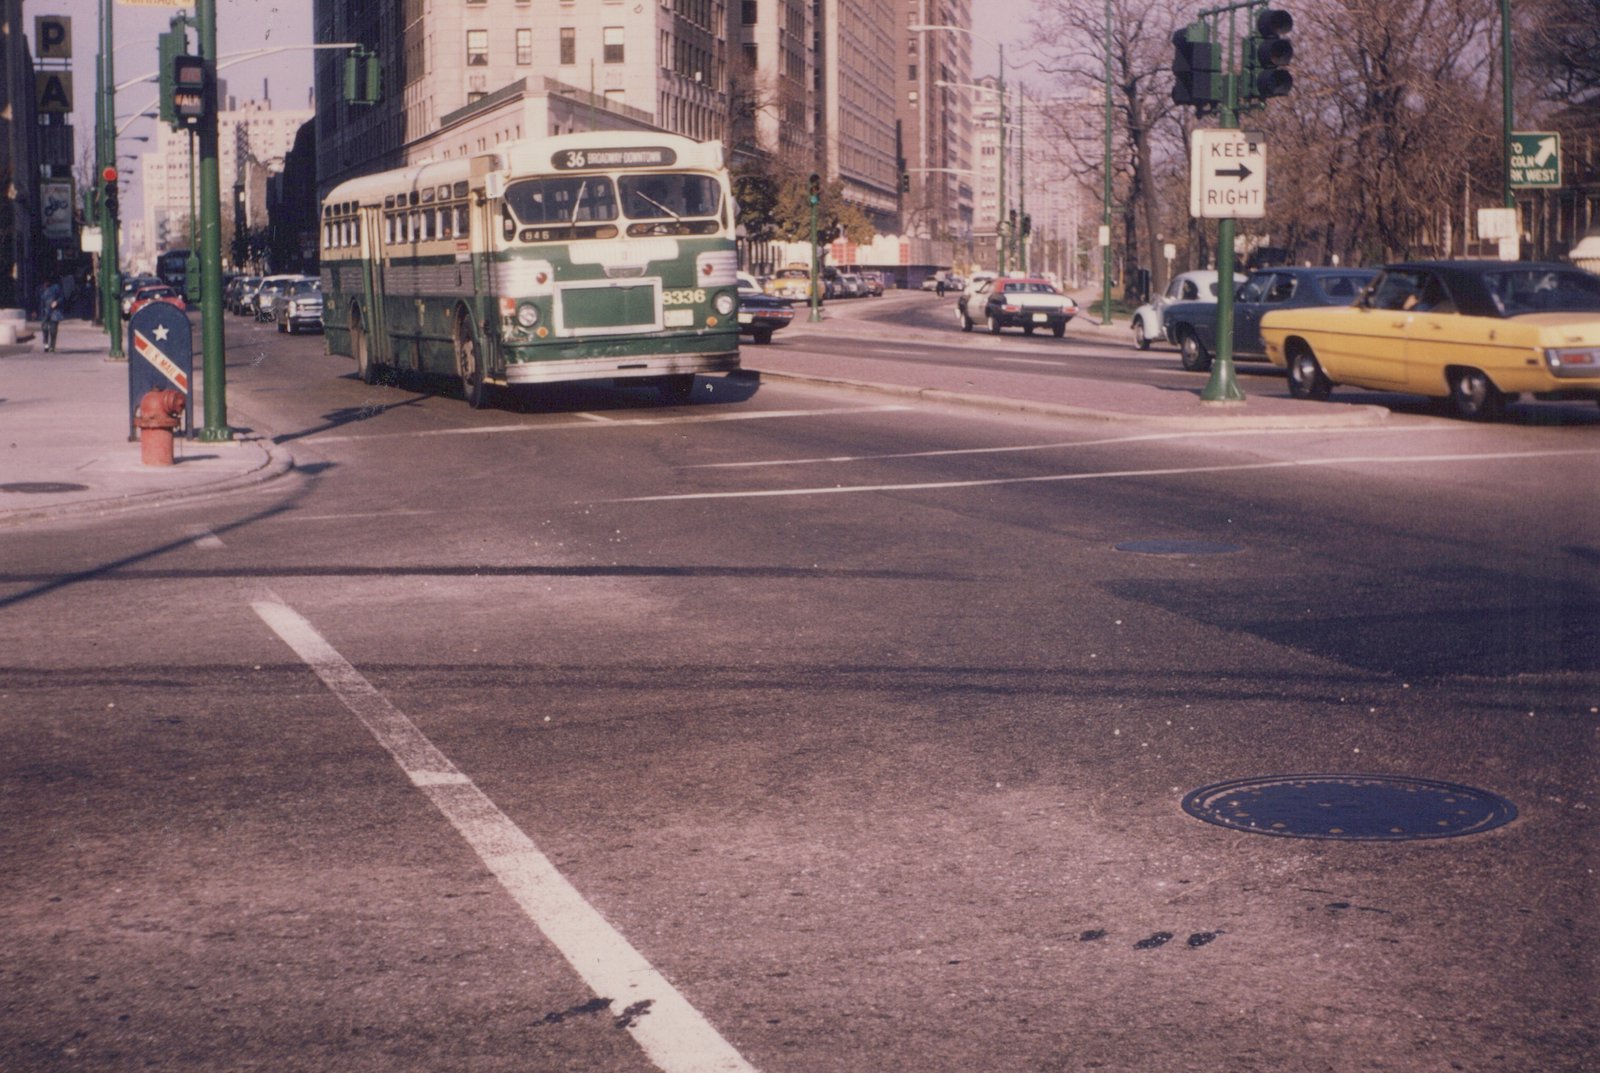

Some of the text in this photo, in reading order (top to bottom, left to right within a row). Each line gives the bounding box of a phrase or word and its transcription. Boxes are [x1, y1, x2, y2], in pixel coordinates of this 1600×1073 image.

[1211, 142, 1261, 157] KEEP
[566, 151, 586, 168] 36
[1525, 169, 1556, 182] WEST
[1207, 189, 1259, 205] RIGHT
[663, 288, 706, 305] 8336
